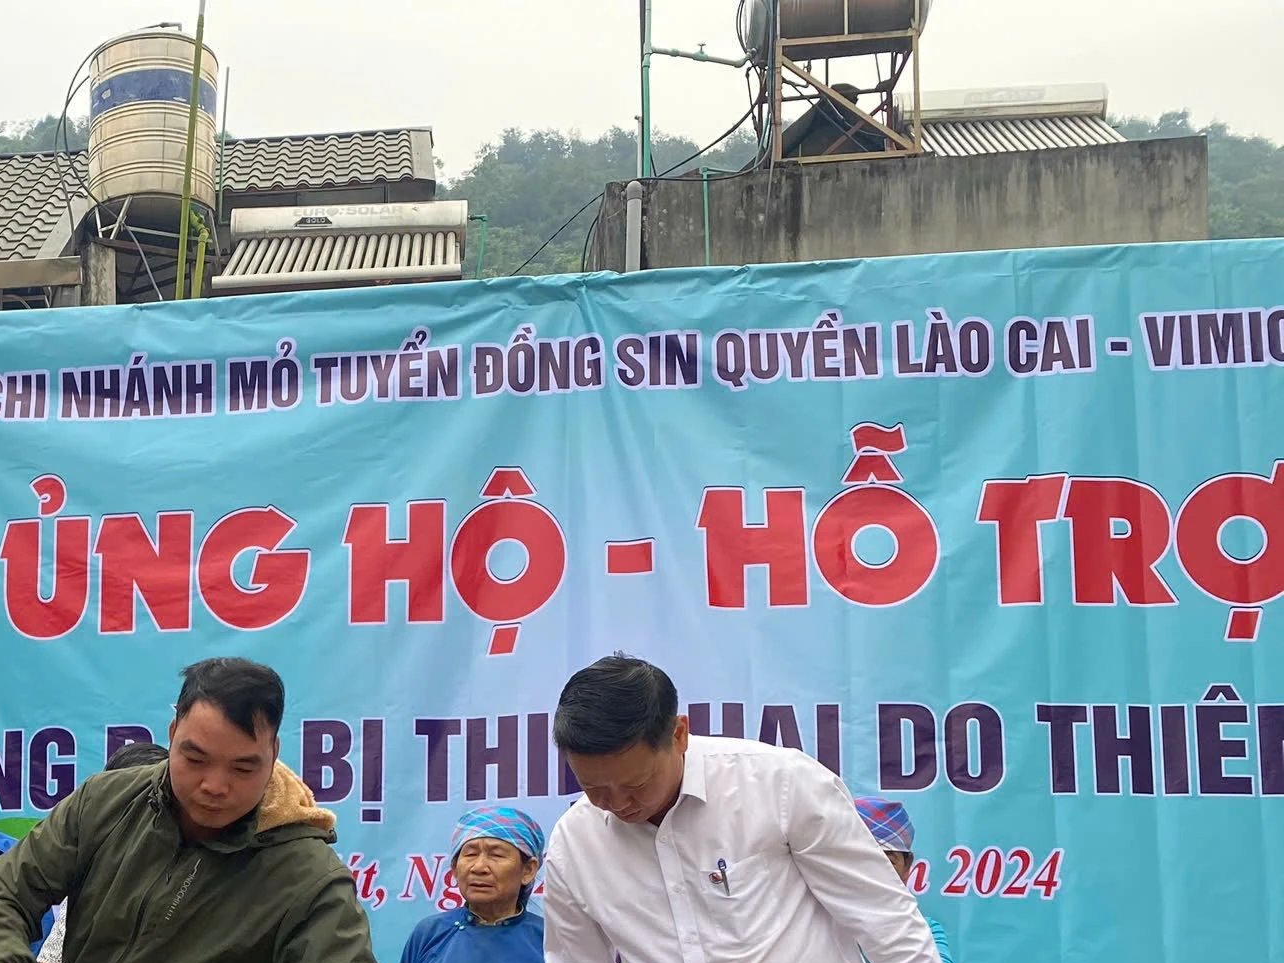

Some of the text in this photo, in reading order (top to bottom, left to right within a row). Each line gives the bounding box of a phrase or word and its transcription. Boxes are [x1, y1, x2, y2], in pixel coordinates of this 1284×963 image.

[60, 355, 214, 418] NHÁNH
[228, 341, 300, 412] MỎ
[313, 330, 459, 404] TUYỂN
[473, 327, 602, 395] ĐỒNG
[616, 333, 699, 387] SIN
[715, 313, 879, 388] QUYỀN
[895, 312, 991, 374] LÀO
[1007, 318, 1093, 374] CAI
[1109, 339, 1129, 353] -
[0, 421, 1284, 656] ỦNG HỘ - HỖ TRỢ
[301, 718, 384, 824] BỊ
[876, 701, 1005, 794] DO
[942, 848, 1062, 898] 2024
